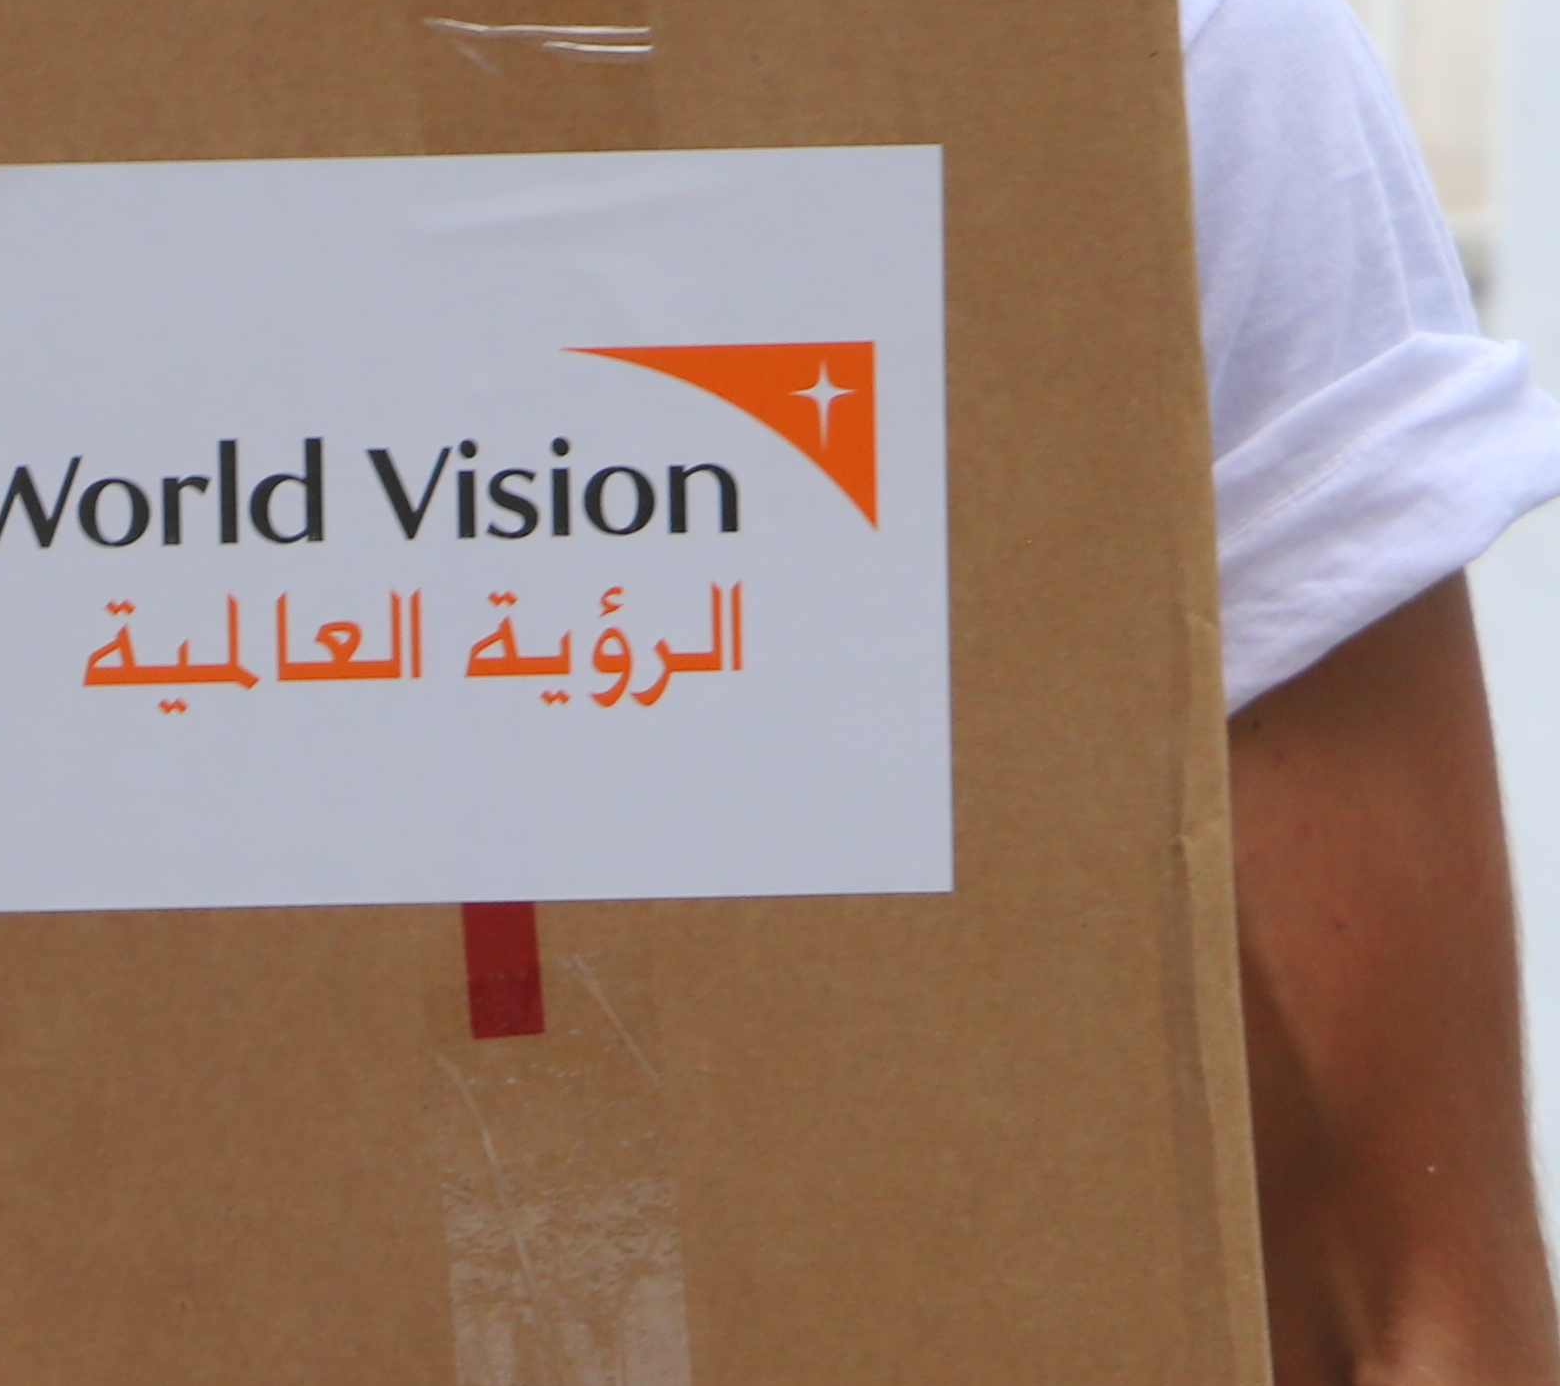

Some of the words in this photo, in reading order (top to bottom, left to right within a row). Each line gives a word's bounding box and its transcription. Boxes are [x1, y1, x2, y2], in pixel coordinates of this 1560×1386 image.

[366, 437, 740, 541] Vision
[83, 589, 423, 715] العالمية
[466, 581, 745, 709] الرؤية
